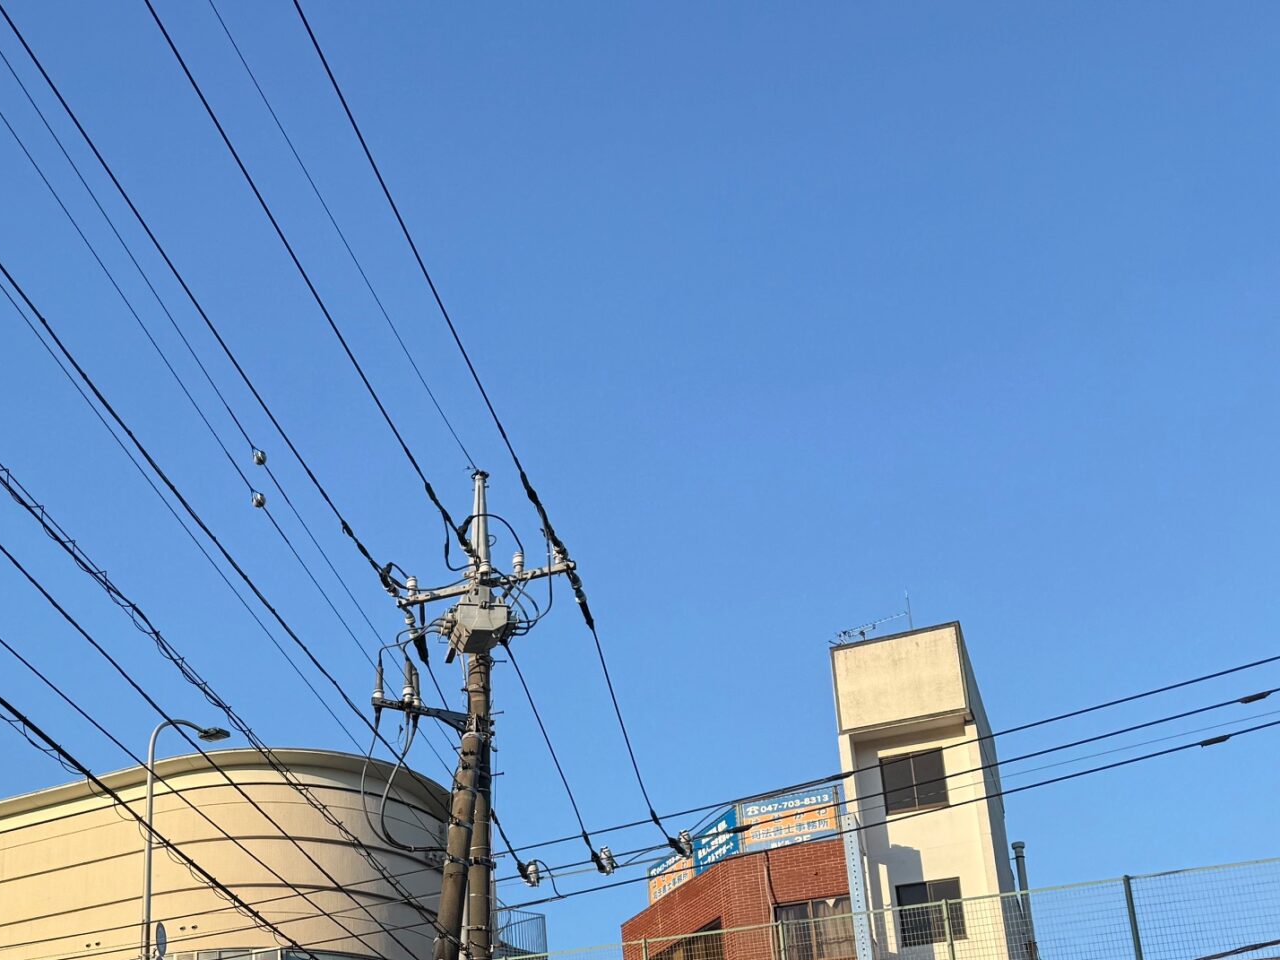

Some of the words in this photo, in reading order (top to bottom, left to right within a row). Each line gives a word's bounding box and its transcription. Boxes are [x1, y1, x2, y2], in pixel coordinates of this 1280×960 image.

[760, 794, 829, 813] 047-703-8313
[751, 820, 829, 839] 司法書士事務所
